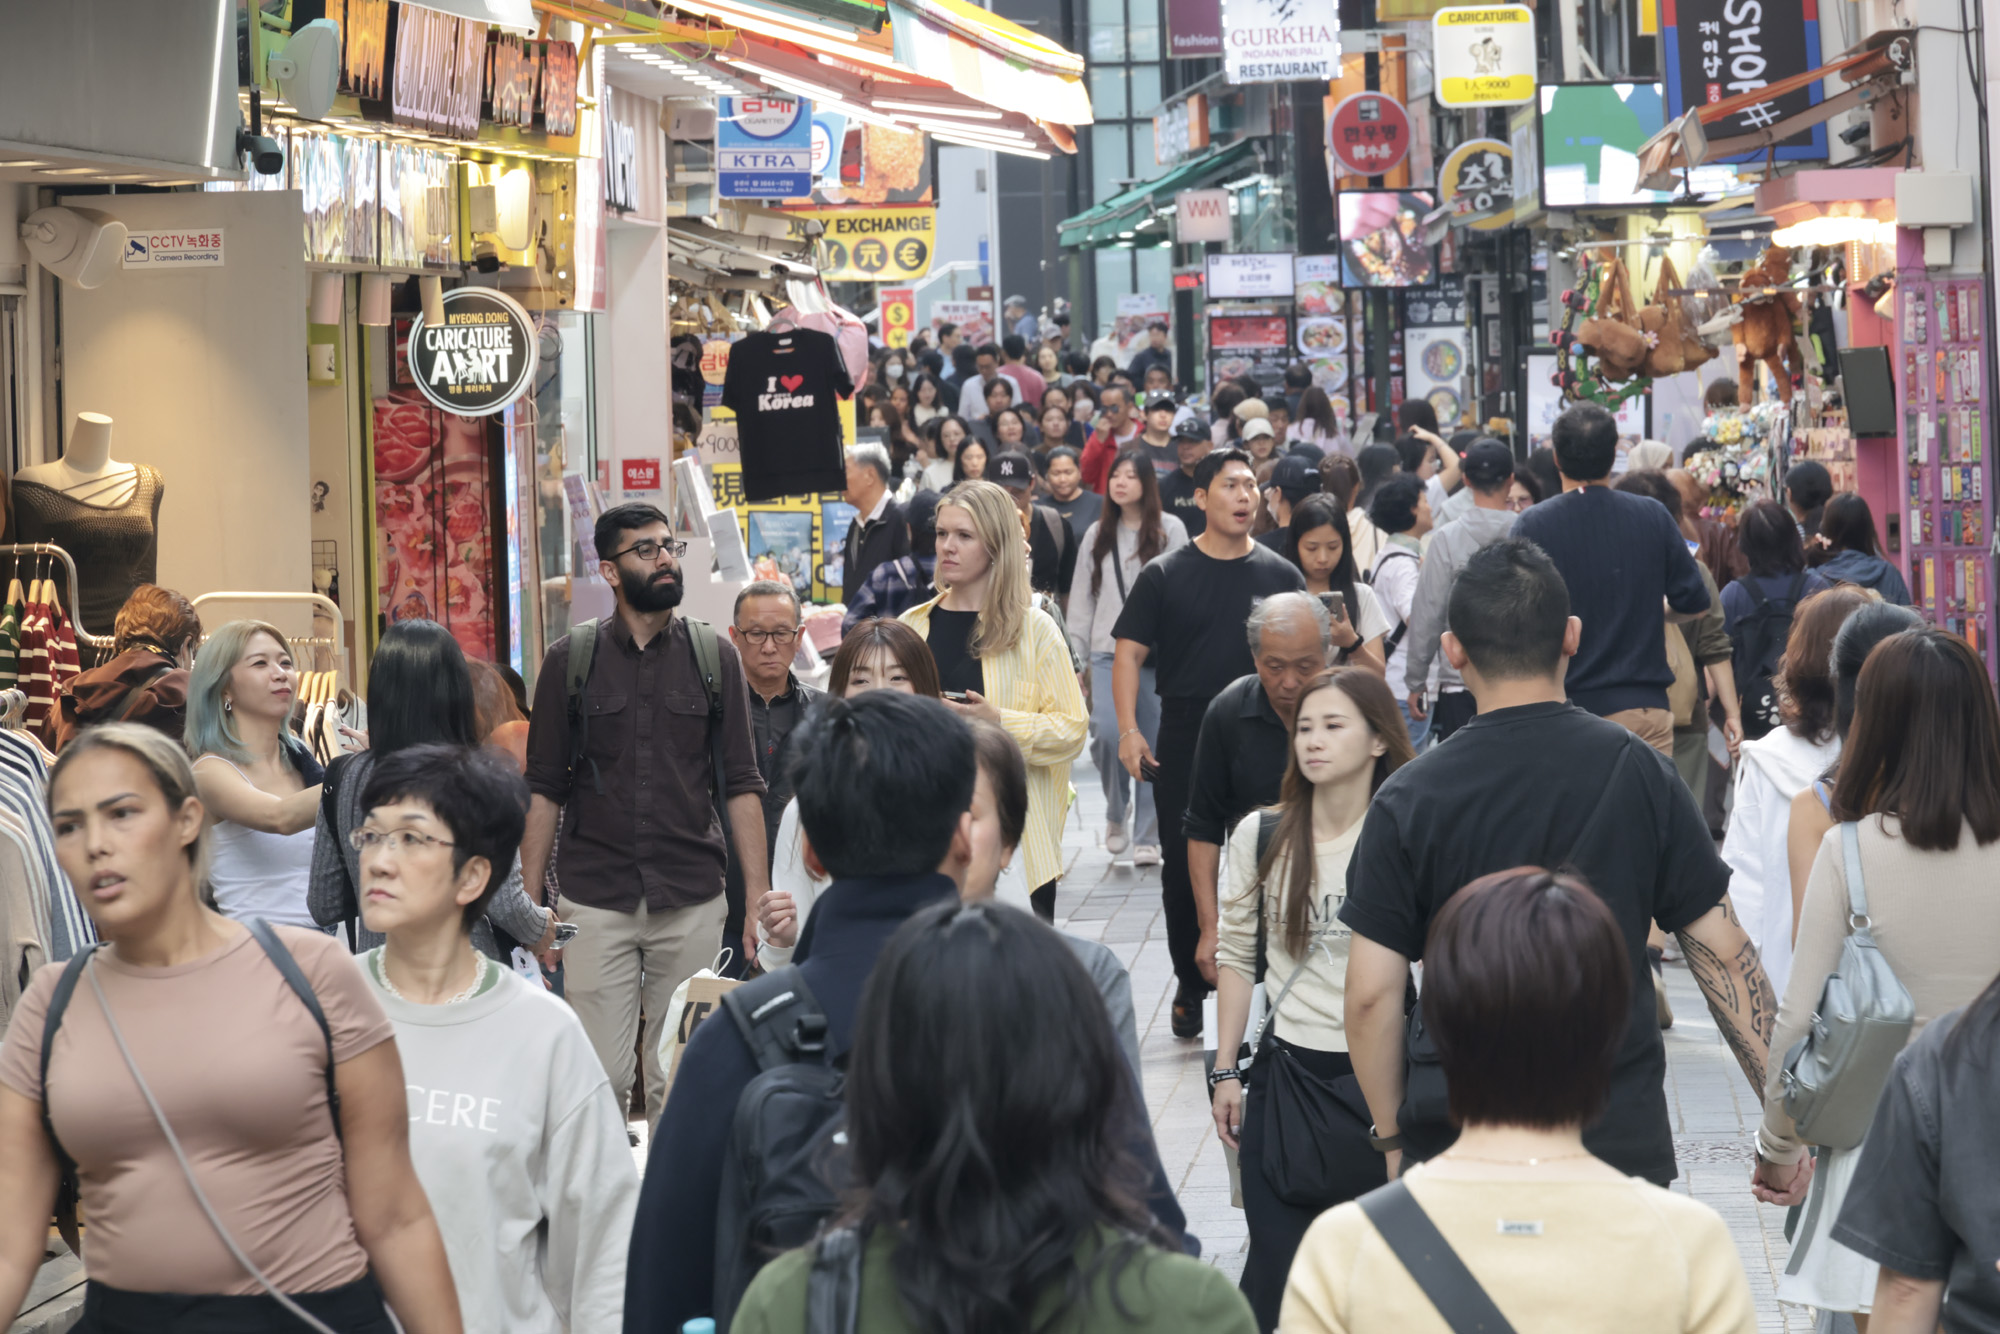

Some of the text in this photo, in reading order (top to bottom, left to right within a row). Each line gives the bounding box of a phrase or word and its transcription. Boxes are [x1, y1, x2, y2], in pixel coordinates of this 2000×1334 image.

[1448, 10, 1519, 23] CARICATURE
[1173, 34, 1219, 47] fashion
[1231, 25, 1332, 47] GURKHA
[1242, 48, 1323, 59] INDIAN/NEPALI
[1239, 61, 1328, 77] RESTAURANT
[733, 154, 795, 167] KTRA
[836, 216, 931, 234] EXCHANGE
[150, 233, 222, 248] CCTV 녹화중
[154, 253, 219, 262] Camera Recording
[449, 312, 509, 325] MYEONG DONG
[425, 326, 513, 351] CARICATURE
[766, 376, 778, 393] I
[758, 393, 814, 412] Korea
